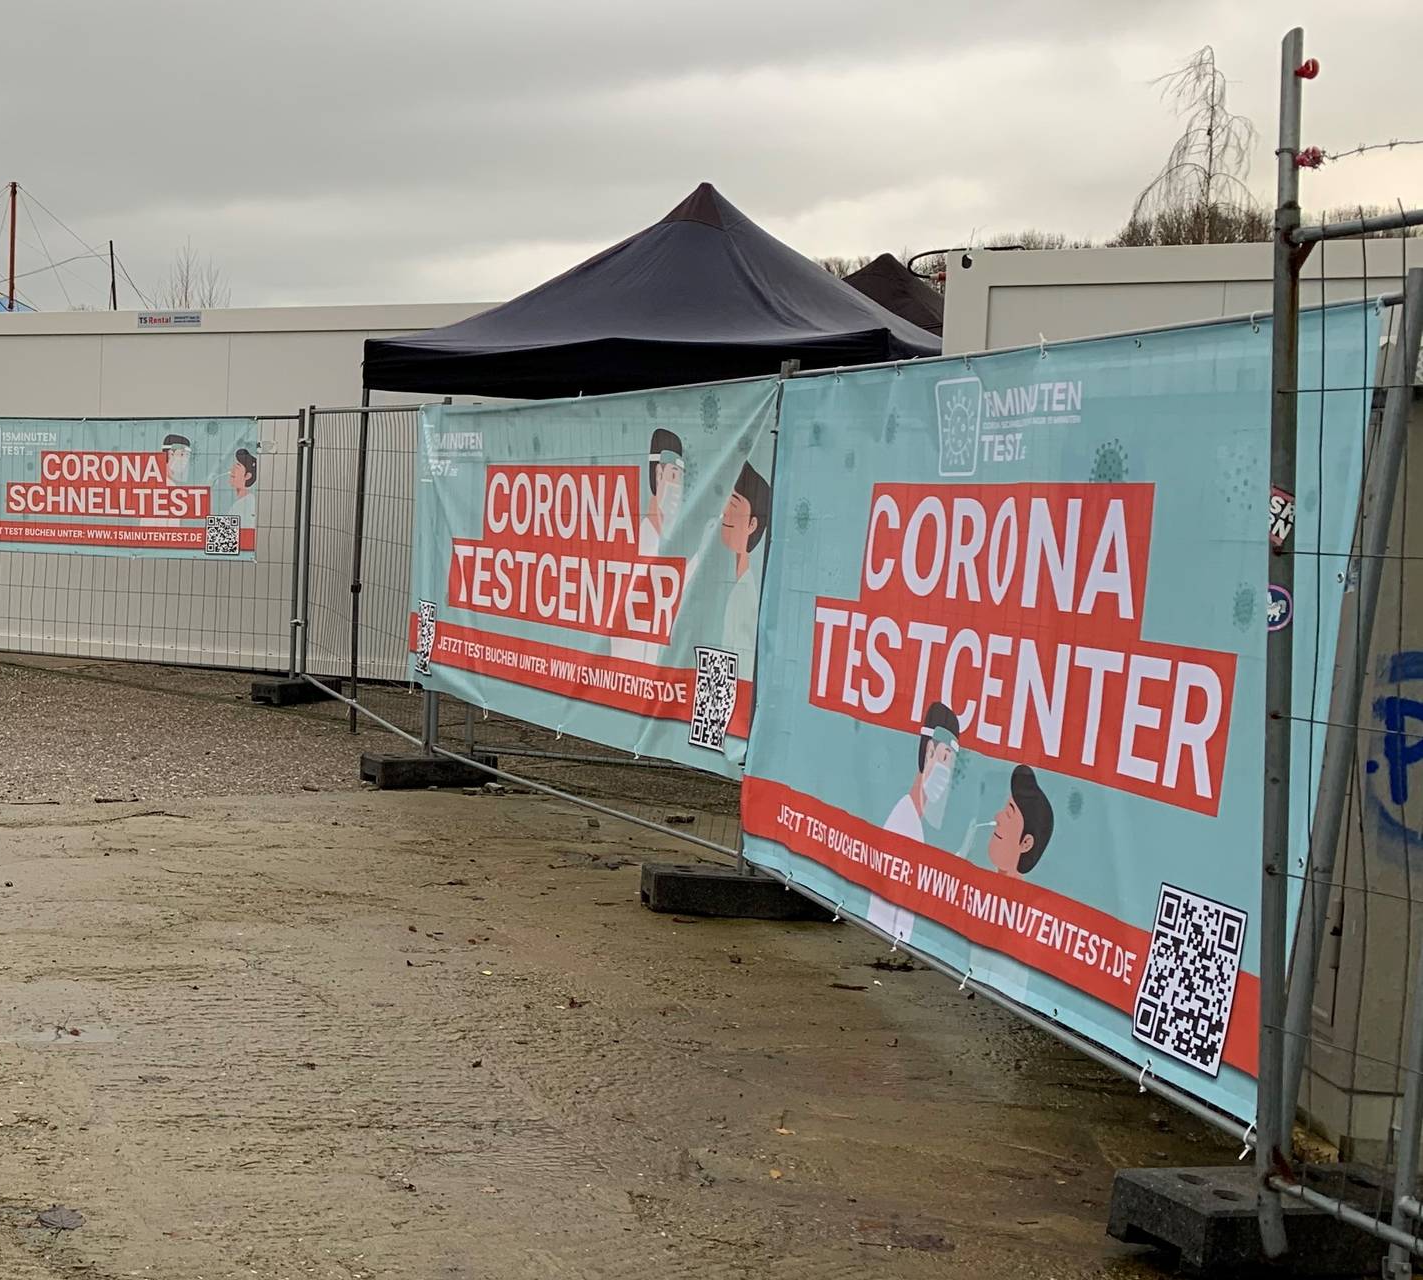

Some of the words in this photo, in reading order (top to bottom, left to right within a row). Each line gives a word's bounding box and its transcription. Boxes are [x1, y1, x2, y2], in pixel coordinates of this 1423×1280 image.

[2, 432, 57, 442] 15MINUTEN
[42, 453, 164, 483] CORONA
[9, 485, 208, 517] SCHNELLTEST
[486, 472, 635, 544] CORONA
[4, 527, 24, 536] TEST
[24, 528, 56, 537] BUCHEN
[57, 529, 86, 539] UNTER:
[87, 530, 202, 543] WWW.15MINUTENTEST.DE
[865, 494, 1134, 620] CORONA
[453, 544, 680, 637] TESTCENTER
[437, 635, 462, 653] JETZT
[462, 643, 486, 660] TEST
[485, 646, 518, 667] BUCHEN
[519, 655, 548, 675] UNTER:
[815, 606, 1222, 799] TESTCENTER
[806, 815, 827, 845] TEST
[827, 827, 869, 866] BUCHEN
[869, 846, 914, 886] UNTER:
[917, 864, 1137, 985] WWW.15MINUTENTEST.DE
